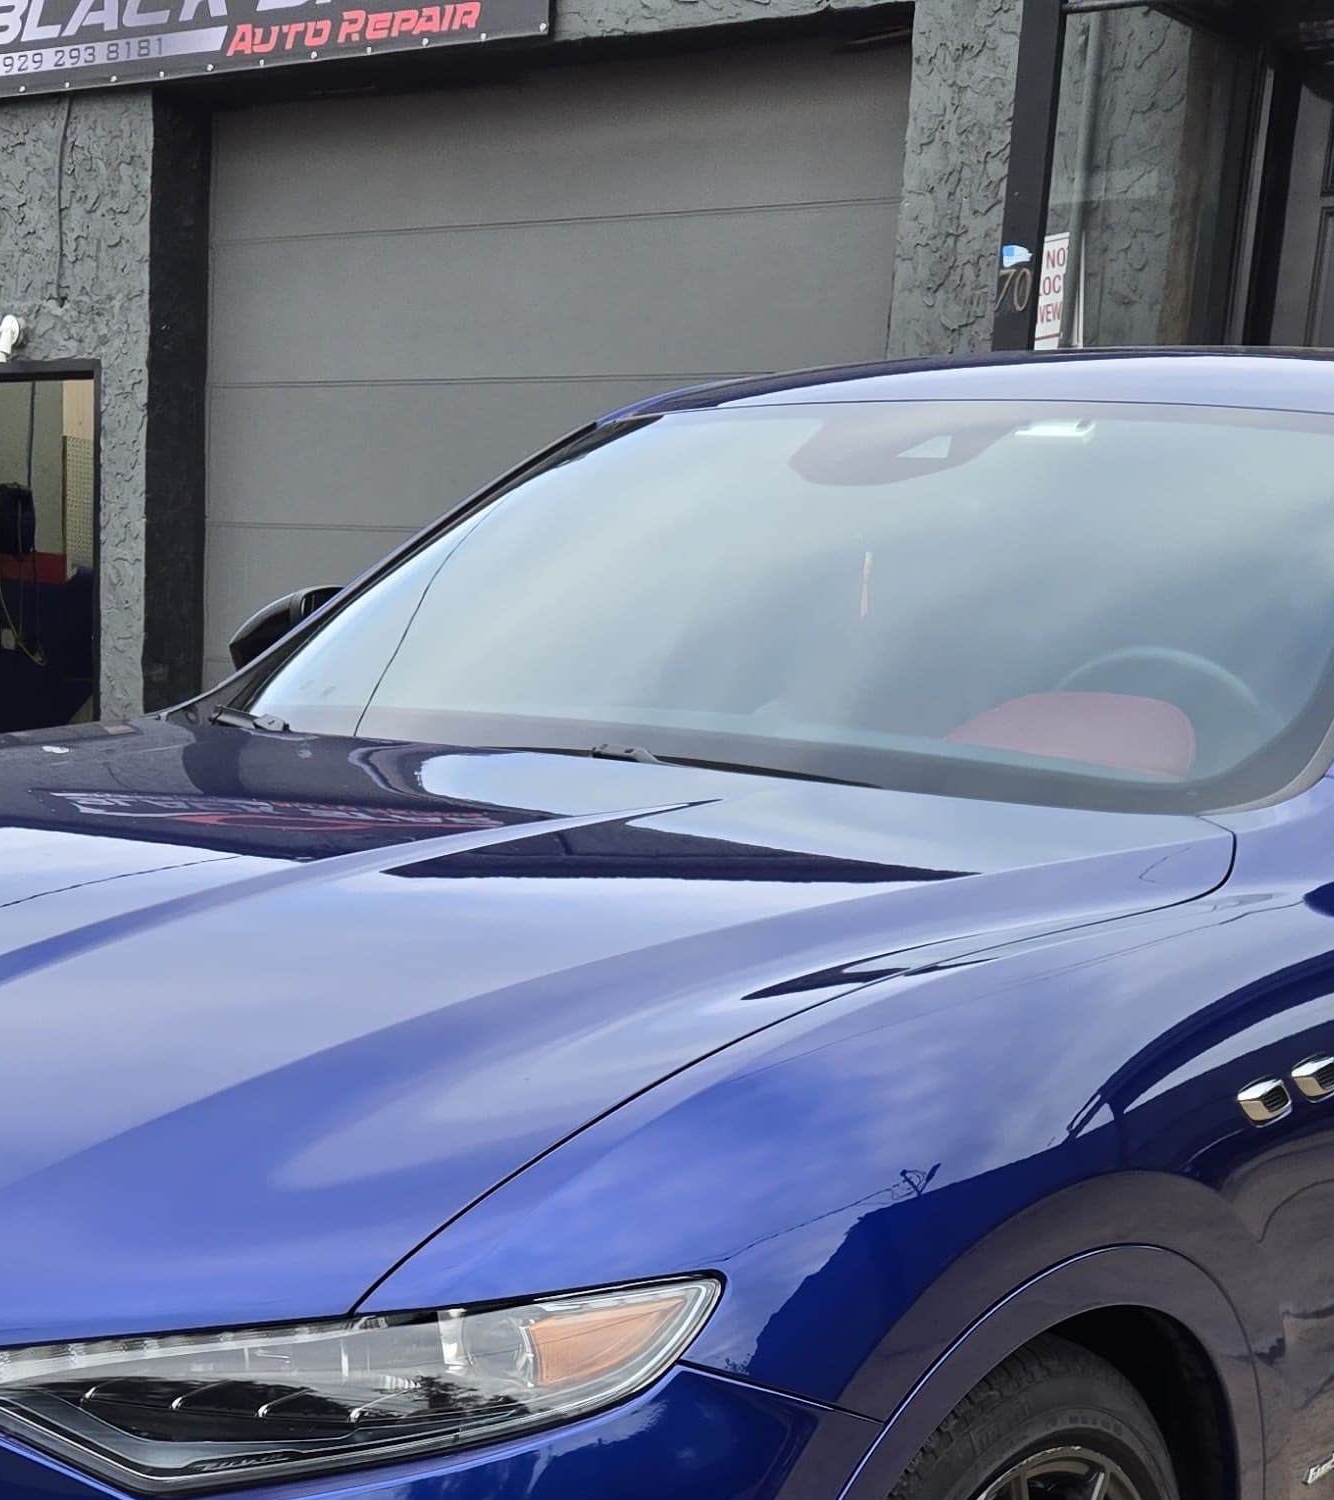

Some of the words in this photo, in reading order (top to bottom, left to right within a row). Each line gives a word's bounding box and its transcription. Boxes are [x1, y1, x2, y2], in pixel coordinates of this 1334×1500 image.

[226, 20, 331, 56] AUTO
[337, 2, 481, 43] REPAIR
[2, 52, 44, 73] 929
[53, 46, 97, 67] 293
[107, 37, 164, 60] 8181
[994, 267, 1033, 312] 70
